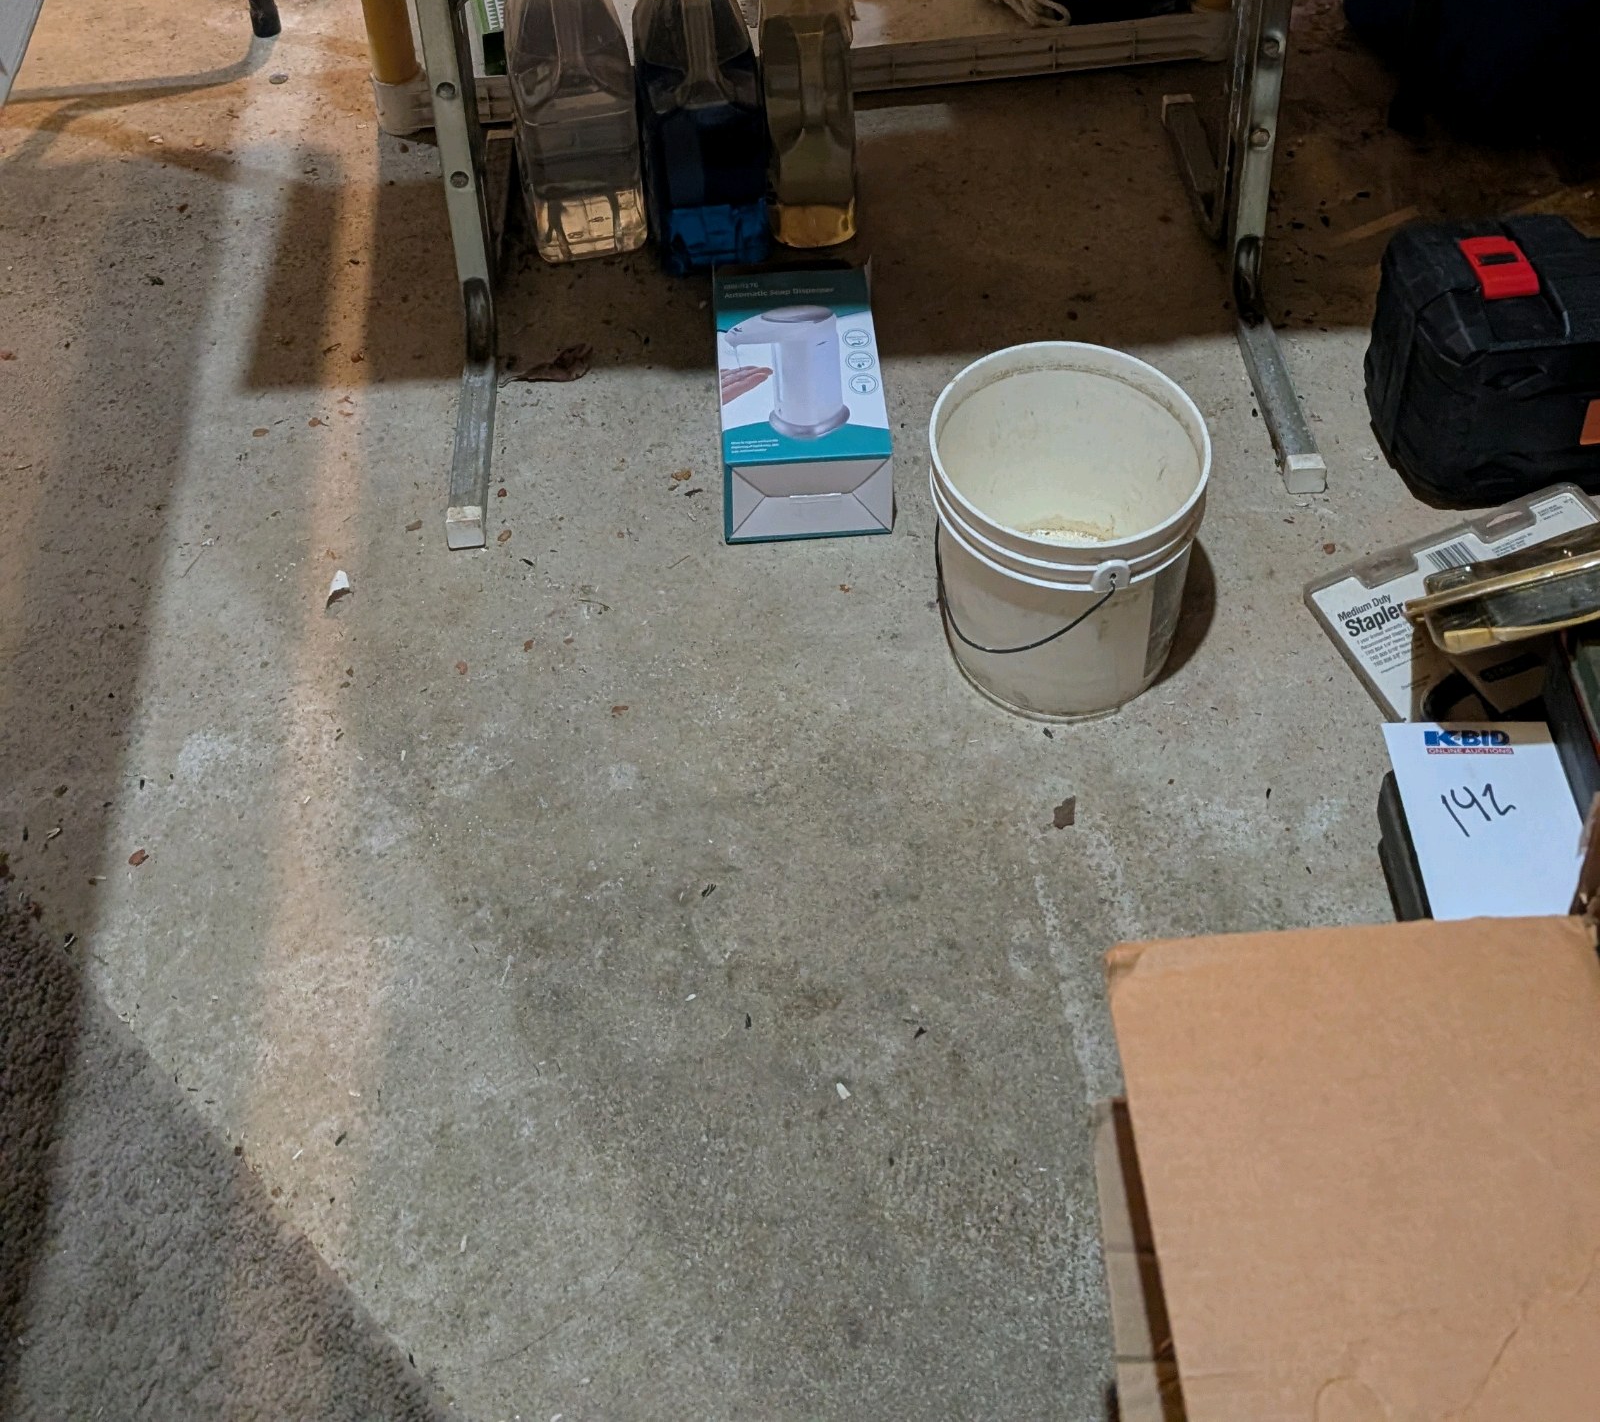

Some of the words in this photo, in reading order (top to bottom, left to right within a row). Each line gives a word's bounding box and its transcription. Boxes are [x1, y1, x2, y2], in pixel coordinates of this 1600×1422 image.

[1337, 601, 1372, 622] Medium
[1372, 594, 1391, 607] Duty
[1345, 602, 1404, 637] Stapler
[1424, 730, 1510, 746] K-BID
[1441, 783, 1516, 837] 142
